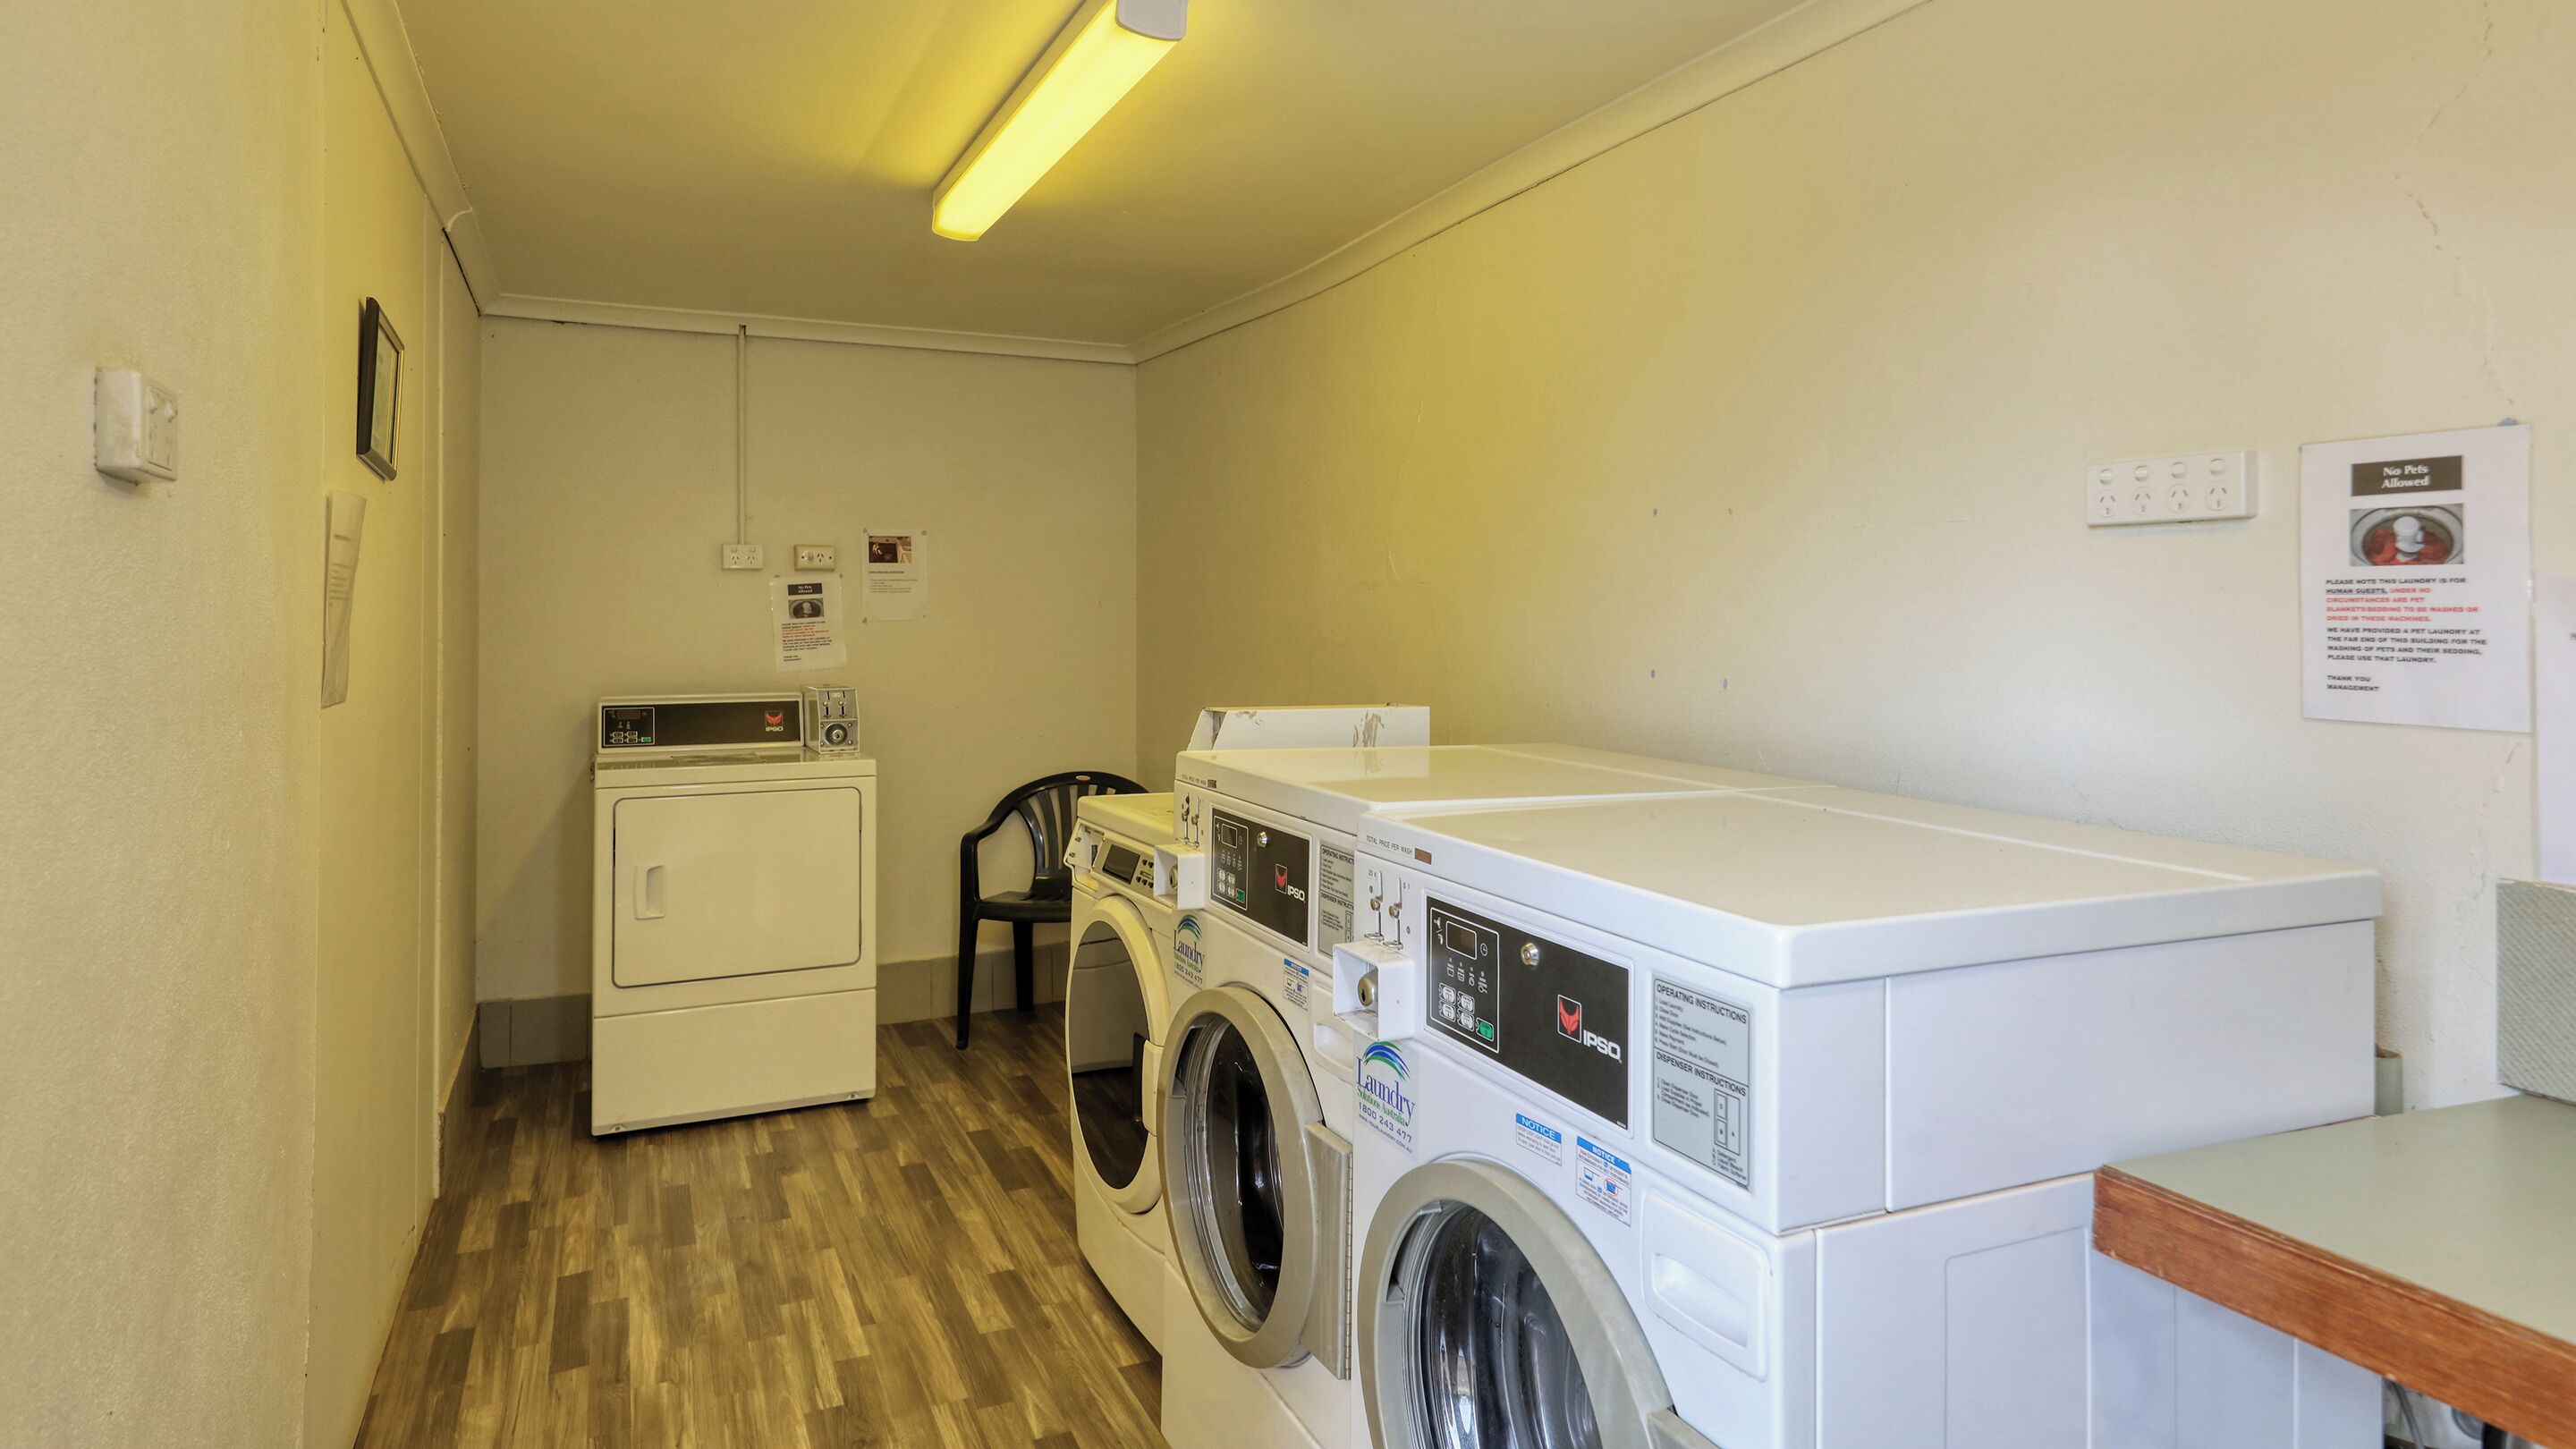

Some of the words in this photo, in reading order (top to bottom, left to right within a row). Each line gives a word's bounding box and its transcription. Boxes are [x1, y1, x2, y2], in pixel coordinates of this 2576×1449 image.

[2381, 475, 2430, 488] Allowed
[2383, 467, 2402, 476] No
[2404, 465, 2429, 474] Pets
[1366, 835, 1377, 844] TOTAL
[1378, 839, 1390, 849] PRICE
[1391, 843, 1399, 851] PER
[1401, 846, 1412, 855] WASH
[1288, 885, 1305, 902] IPSO
[1174, 929, 1205, 973] Laundry
[1185, 968, 1193, 979] 243
[1194, 975, 1202, 984] 477
[1657, 984, 1693, 1004] OPERATING
[1695, 998, 1746, 1024] INSTRUCTIONS
[1583, 1030, 1621, 1060] IPSO
[1657, 1052, 1693, 1073] DISPENSER
[1694, 1070, 1746, 1096] INSTRUCTIONS
[1356, 1056, 1415, 1127] Laundry
[1358, 1087, 1381, 1110] Solutions
[1382, 1103, 1405, 1127] Australia
[1359, 1102, 1377, 1120] 1800
[1379, 1115, 1394, 1131] 243
[1396, 1128, 1412, 1143] 477
[1522, 1117, 1556, 1140] NOTICE
[1592, 1146, 1615, 1164] NOTICE
